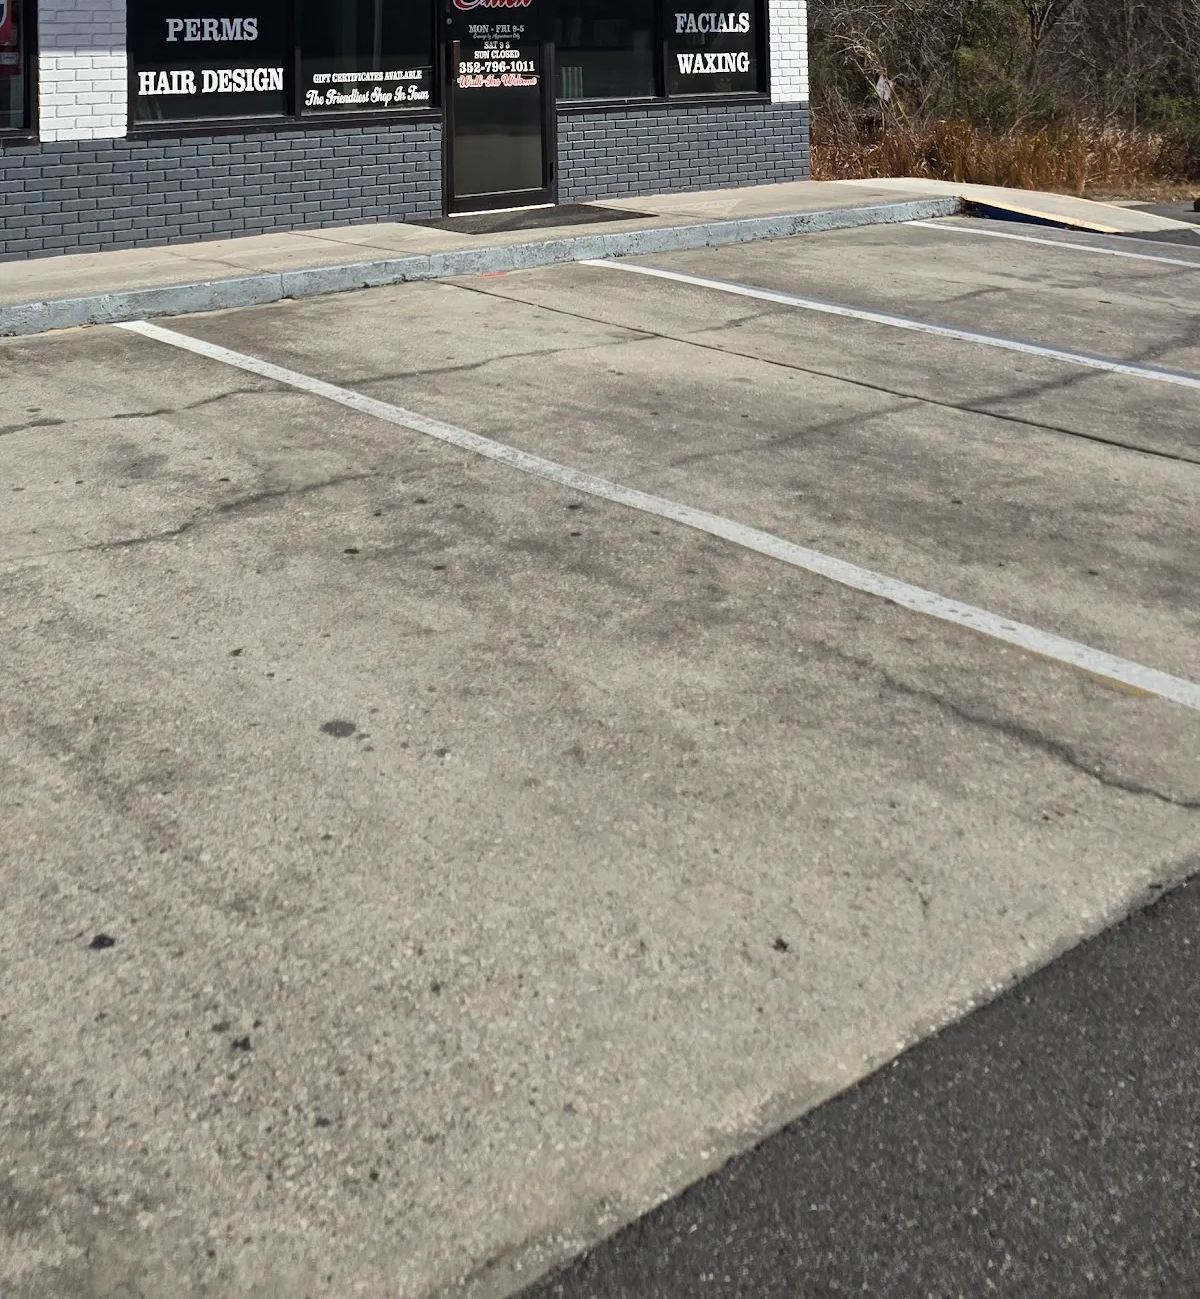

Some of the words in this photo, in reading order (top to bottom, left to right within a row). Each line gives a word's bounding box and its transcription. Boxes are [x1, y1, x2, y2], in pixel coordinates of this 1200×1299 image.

[165, 17, 259, 42] PERMS
[468, 24, 489, 33] MON
[496, 24, 511, 33] FRI
[512, 24, 525, 33] 9-5
[675, 12, 750, 34] FACIALS
[484, 41, 497, 50] SAT
[474, 50, 490, 59] SUN
[491, 49, 520, 59] CLOSED
[459, 60, 535, 73] 352-796-1011
[676, 52, 750, 74] WAXING
[138, 70, 196, 96] HAIR
[201, 67, 284, 93] DESIGN
[313, 73, 331, 83] GIFT
[332, 72, 384, 83] CERTIFICATES
[384, 70, 422, 81] AVAILABLE
[501, 73, 537, 87] Welcome
[305, 90, 324, 106] The
[325, 88, 369, 105] Friendliest
[370, 86, 392, 107] Shop
[394, 86, 406, 101] In
[407, 84, 429, 101] Town
